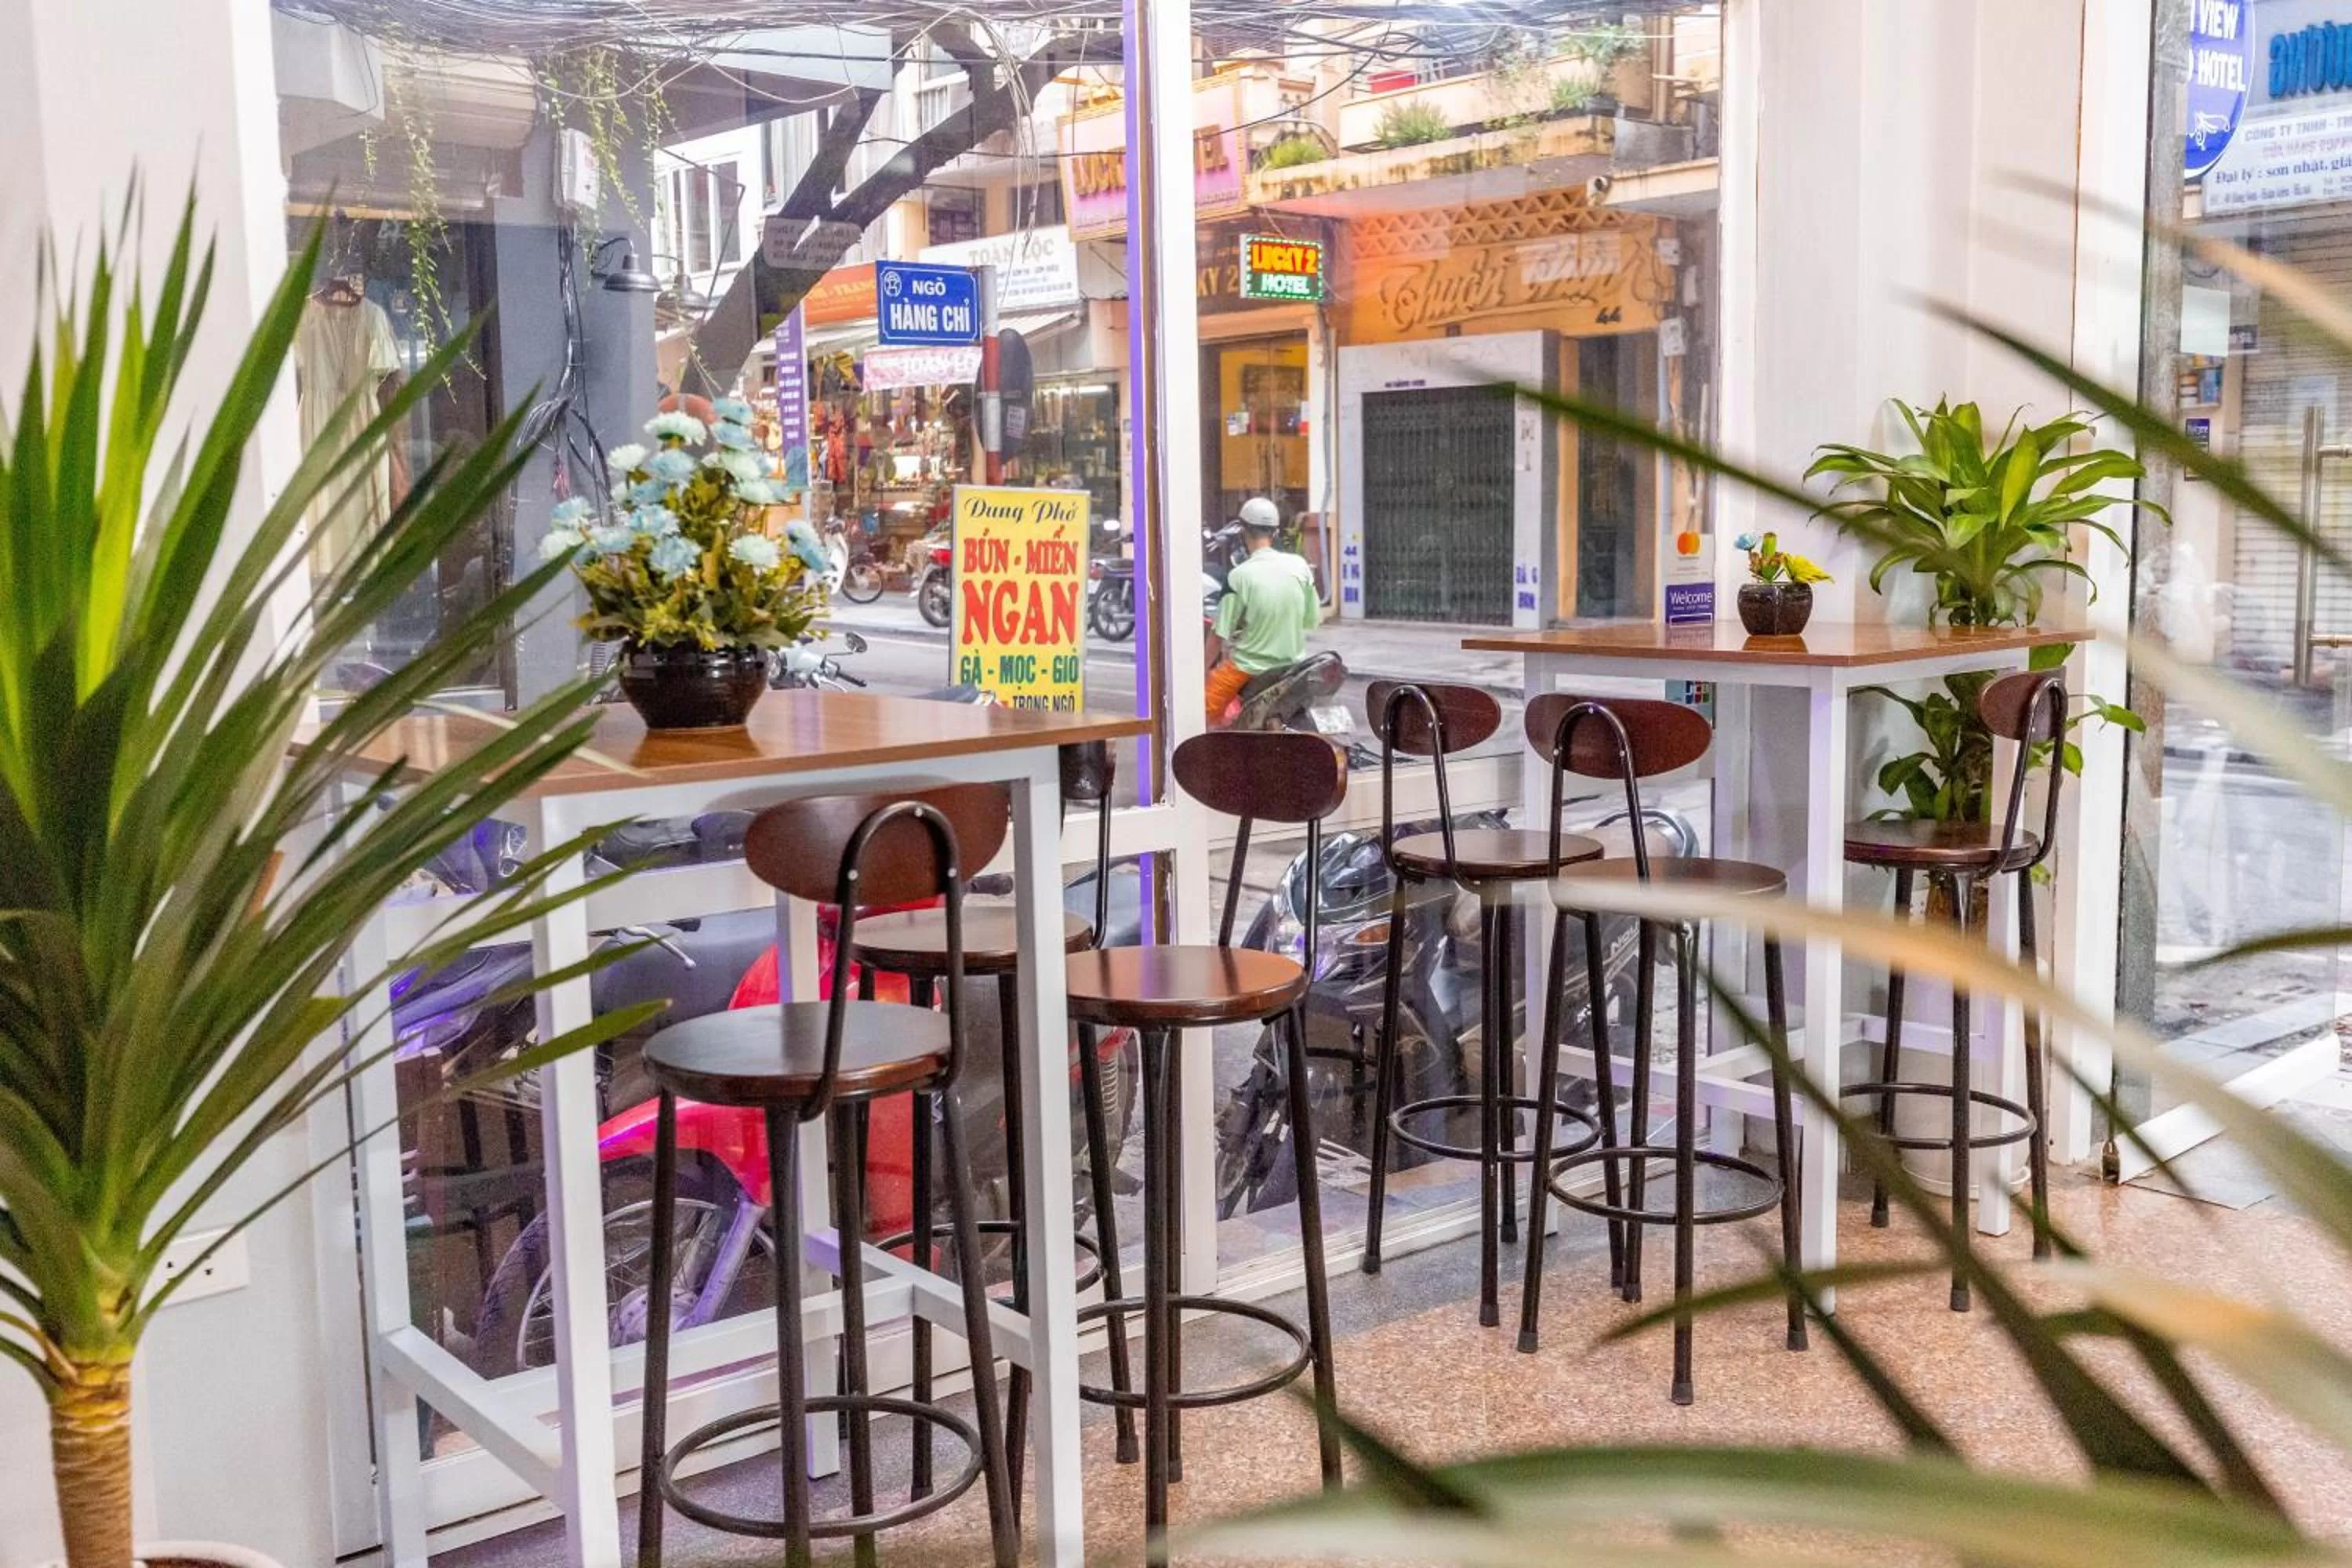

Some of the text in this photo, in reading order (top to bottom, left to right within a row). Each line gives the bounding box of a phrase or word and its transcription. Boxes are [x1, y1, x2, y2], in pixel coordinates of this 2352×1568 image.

[2198, 48, 2246, 92] HOTEL
[1252, 244, 1317, 273] LUCKY 2
[912, 277, 946, 296] NGÕ
[1261, 274, 1310, 294] HOTEL
[890, 297, 970, 332] HÀNG CHỈ
[963, 527, 1011, 574] BÚN
[962, 579, 1079, 645] NGAN
[1669, 590, 1712, 605] Welcome
[960, 648, 982, 684] GÀ
[999, 655, 1036, 690] MỌC
[1610, 920, 1640, 956] NOU
